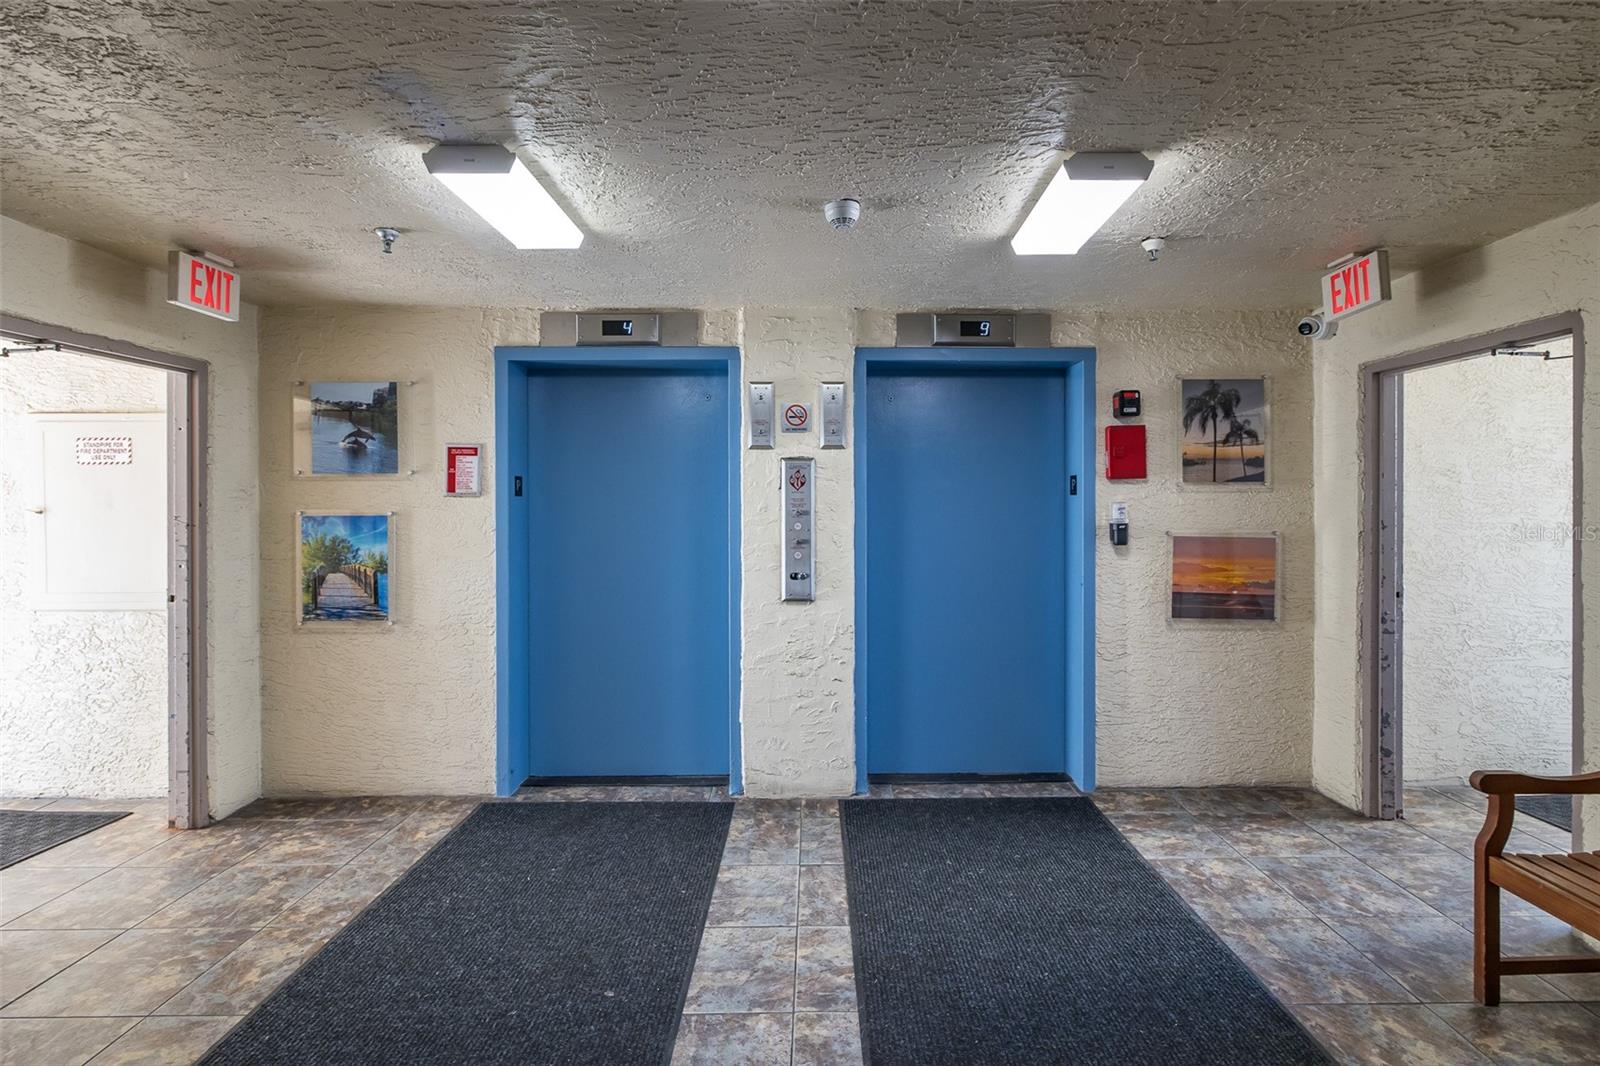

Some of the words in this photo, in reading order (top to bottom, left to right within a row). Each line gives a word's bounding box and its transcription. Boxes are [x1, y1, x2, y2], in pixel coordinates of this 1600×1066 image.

[190, 259, 235, 314] EXIT
[1330, 258, 1370, 315] EXIT
[623, 322, 633, 334] 4
[980, 322, 990, 336] 9
